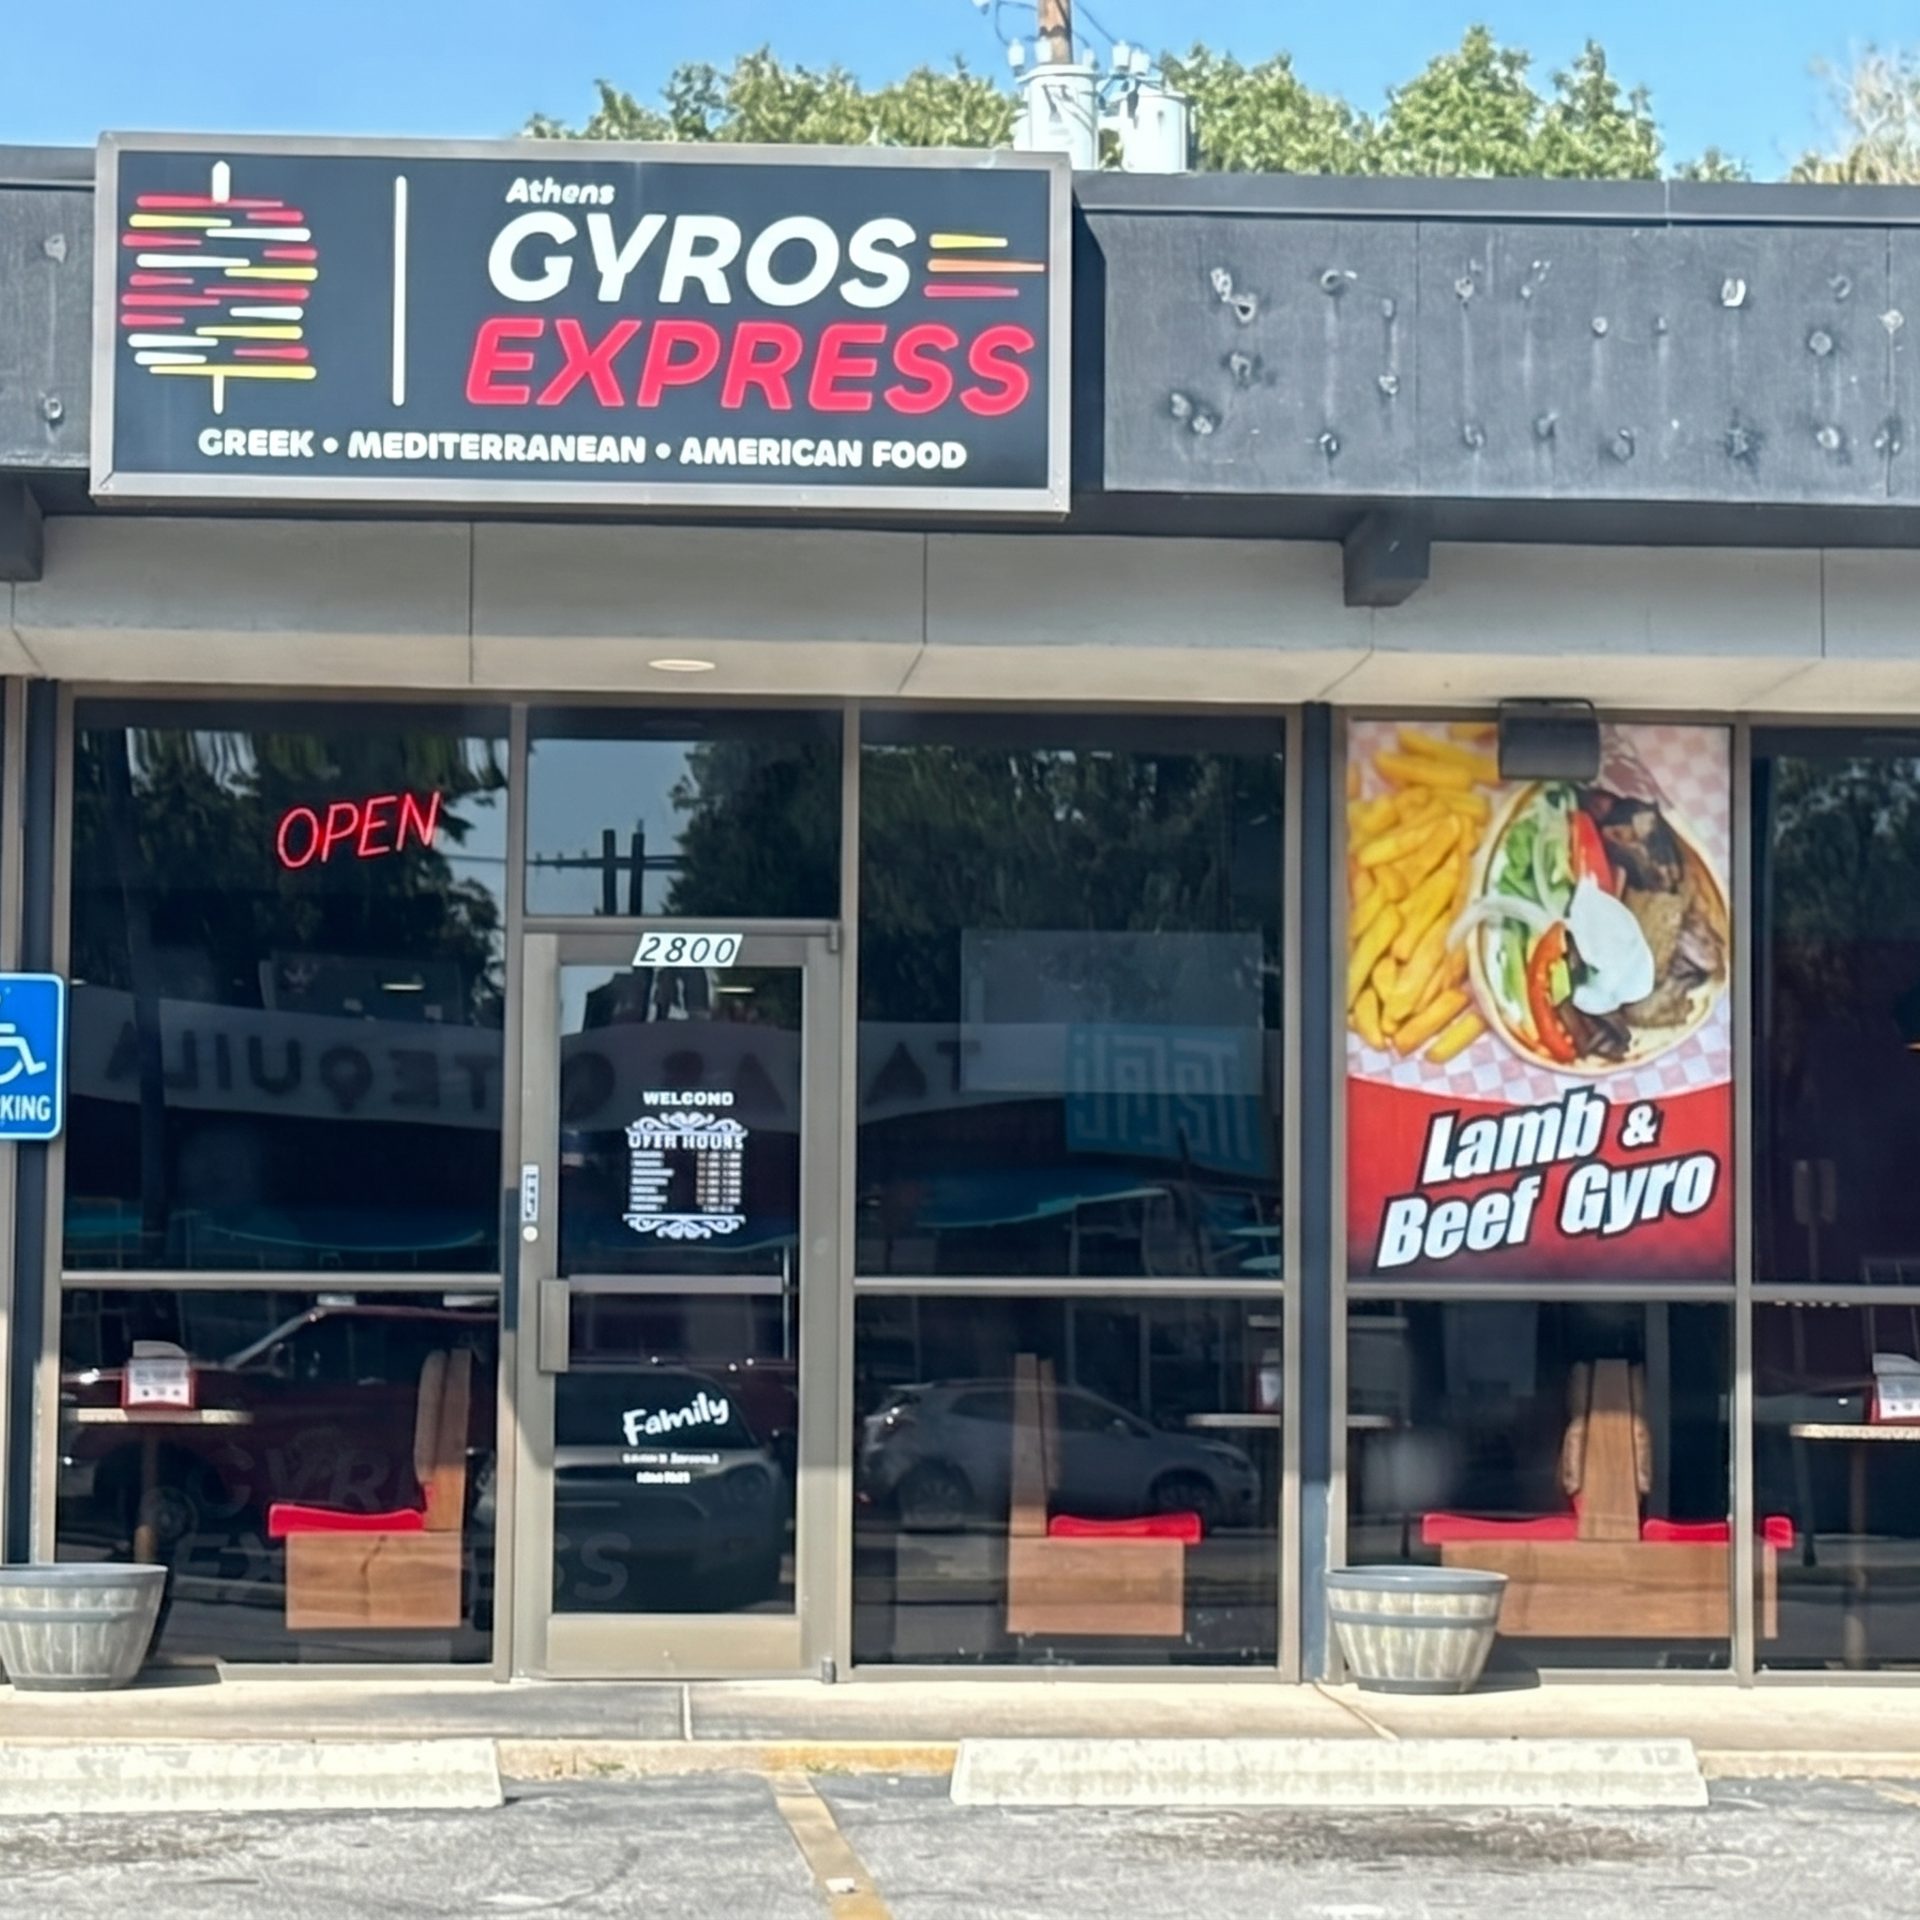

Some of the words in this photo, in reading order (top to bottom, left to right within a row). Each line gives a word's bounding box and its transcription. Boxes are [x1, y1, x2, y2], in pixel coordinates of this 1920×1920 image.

[505, 176, 616, 206] Athens
[488, 210, 917, 309] GYROS
[465, 317, 1035, 417] EXPRESS
[198, 428, 315, 458] GREEK
[348, 431, 646, 464] MEDITERRANEAN
[679, 436, 863, 468] AMERICAN
[872, 440, 968, 470] FOOD
[276, 790, 440, 869] OPEN
[640, 936, 736, 964] 2800
[1421, 1088, 1609, 1187] Lamb
[1620, 1103, 1661, 1149] &
[1376, 1173, 1543, 1270] Beef
[1558, 1153, 1718, 1237] Gyro
[622, 1391, 730, 1447] Family
